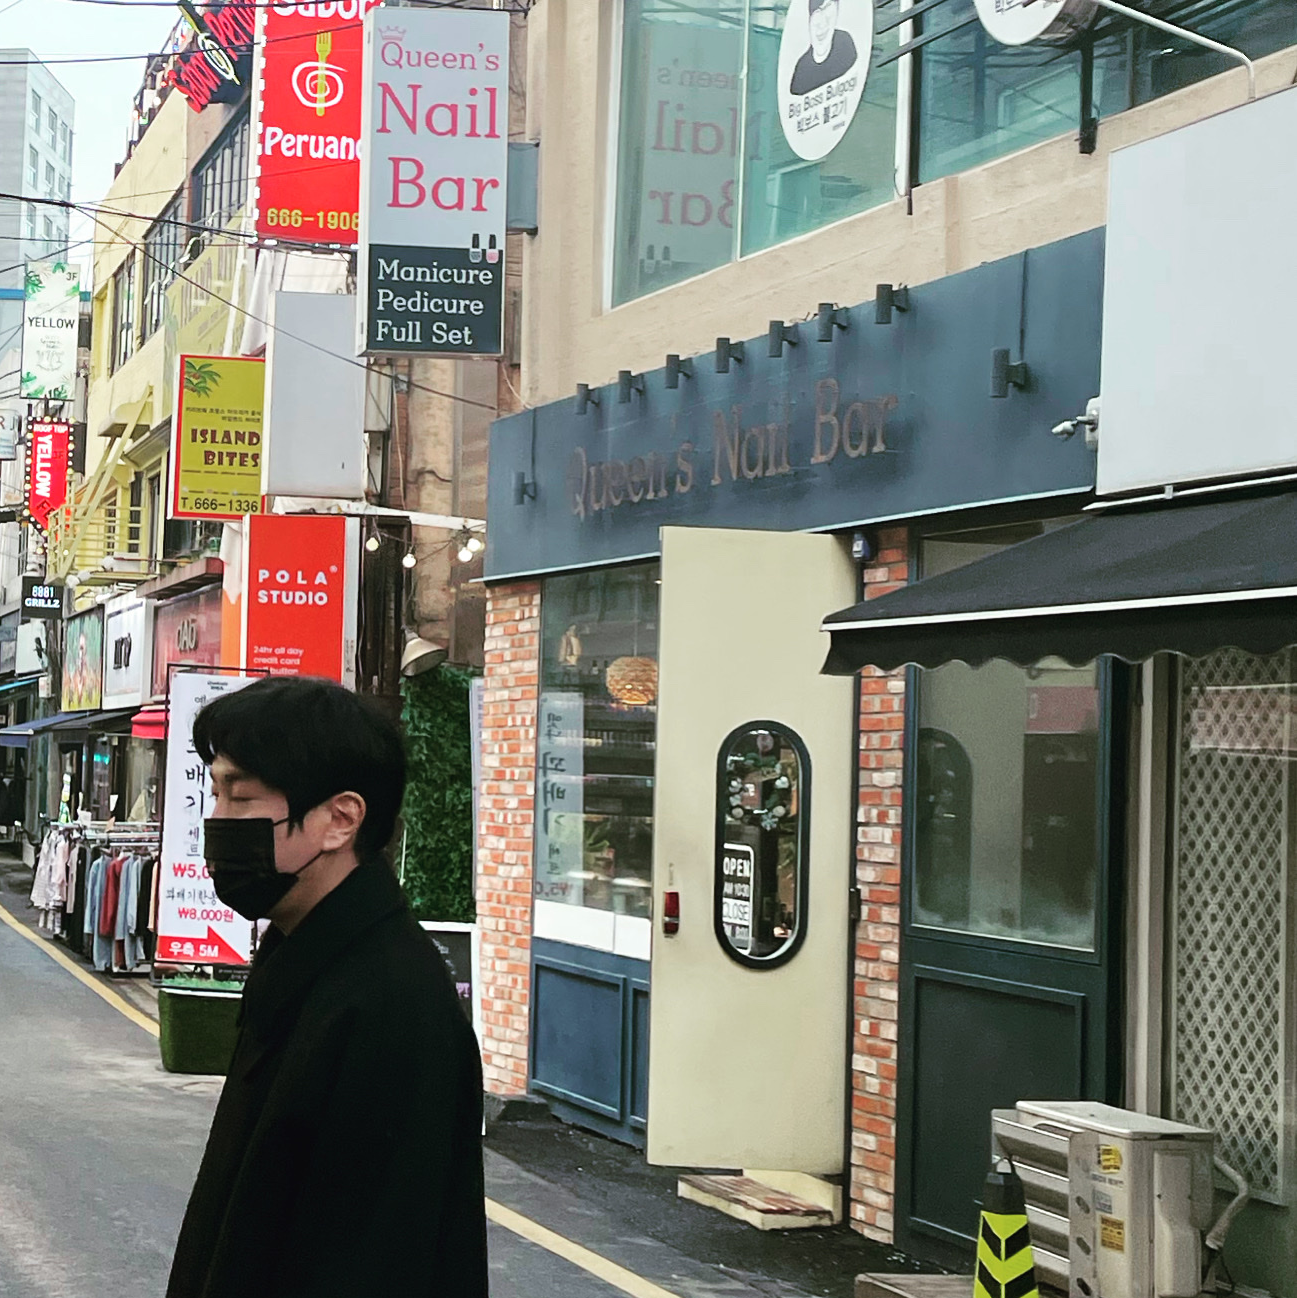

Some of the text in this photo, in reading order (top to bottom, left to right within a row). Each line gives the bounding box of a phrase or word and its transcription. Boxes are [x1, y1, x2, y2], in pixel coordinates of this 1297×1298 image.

[381, 41, 500, 71] Queen's
[376, 82, 501, 139] Nail
[804, 91, 824, 112] Boss
[386, 156, 500, 212] Bar
[377, 258, 494, 286] Manicure
[376, 288, 485, 316] Pedicure
[27, 316, 76, 330] YELLOW
[375, 319, 474, 346] Full Set
[190, 427, 261, 447] ISLAND
[203, 450, 260, 468] BITES
[568, 377, 899, 522] Queen's Nail Bar
[35, 434, 53, 498] YELLOW
[258, 568, 328, 586] POLA
[257, 589, 328, 606] STUDIO
[280, 657, 301, 666] card
[722, 856, 751, 878] OPEN
[198, 944, 220, 958] 5M
